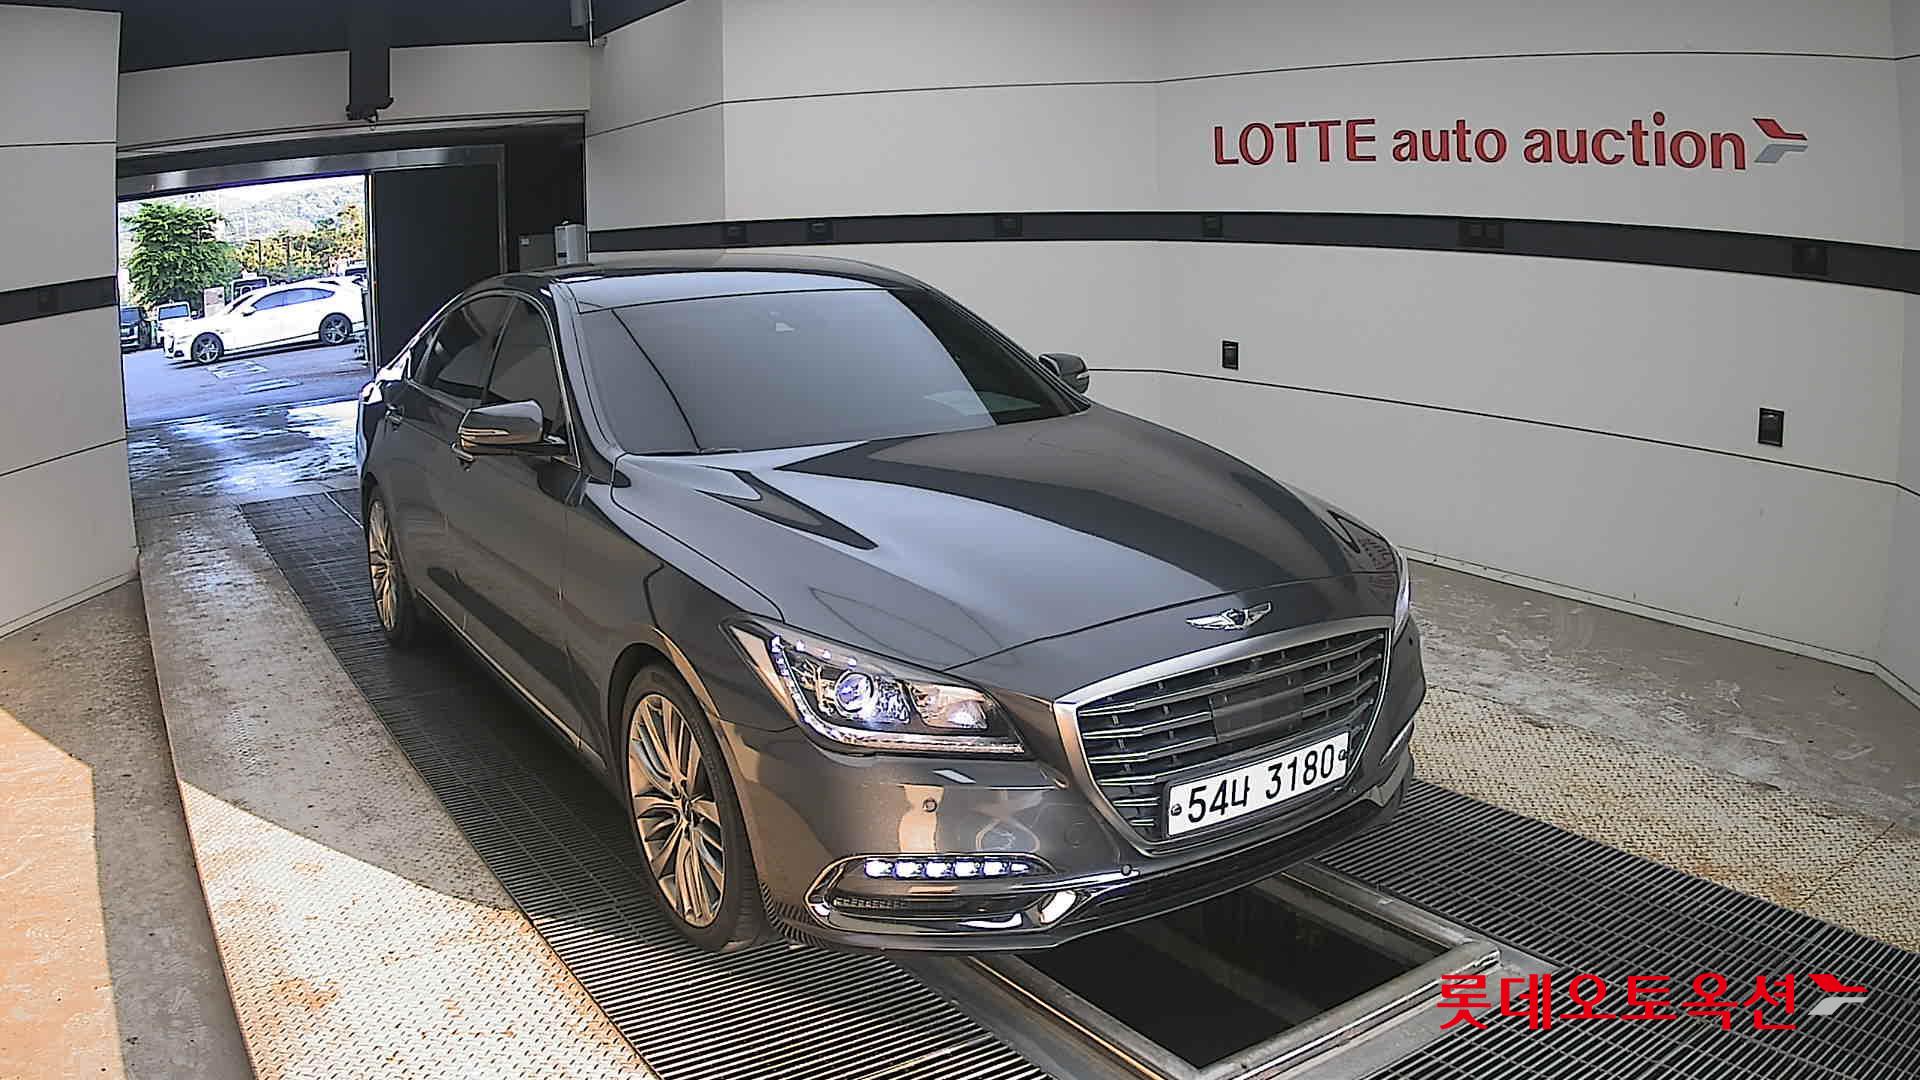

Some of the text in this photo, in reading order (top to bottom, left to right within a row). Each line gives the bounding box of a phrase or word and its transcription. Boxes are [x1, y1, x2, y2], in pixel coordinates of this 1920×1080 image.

[1213, 111, 1746, 170] LOTTE auto auction
[1187, 744, 1335, 823] 54나 3180
